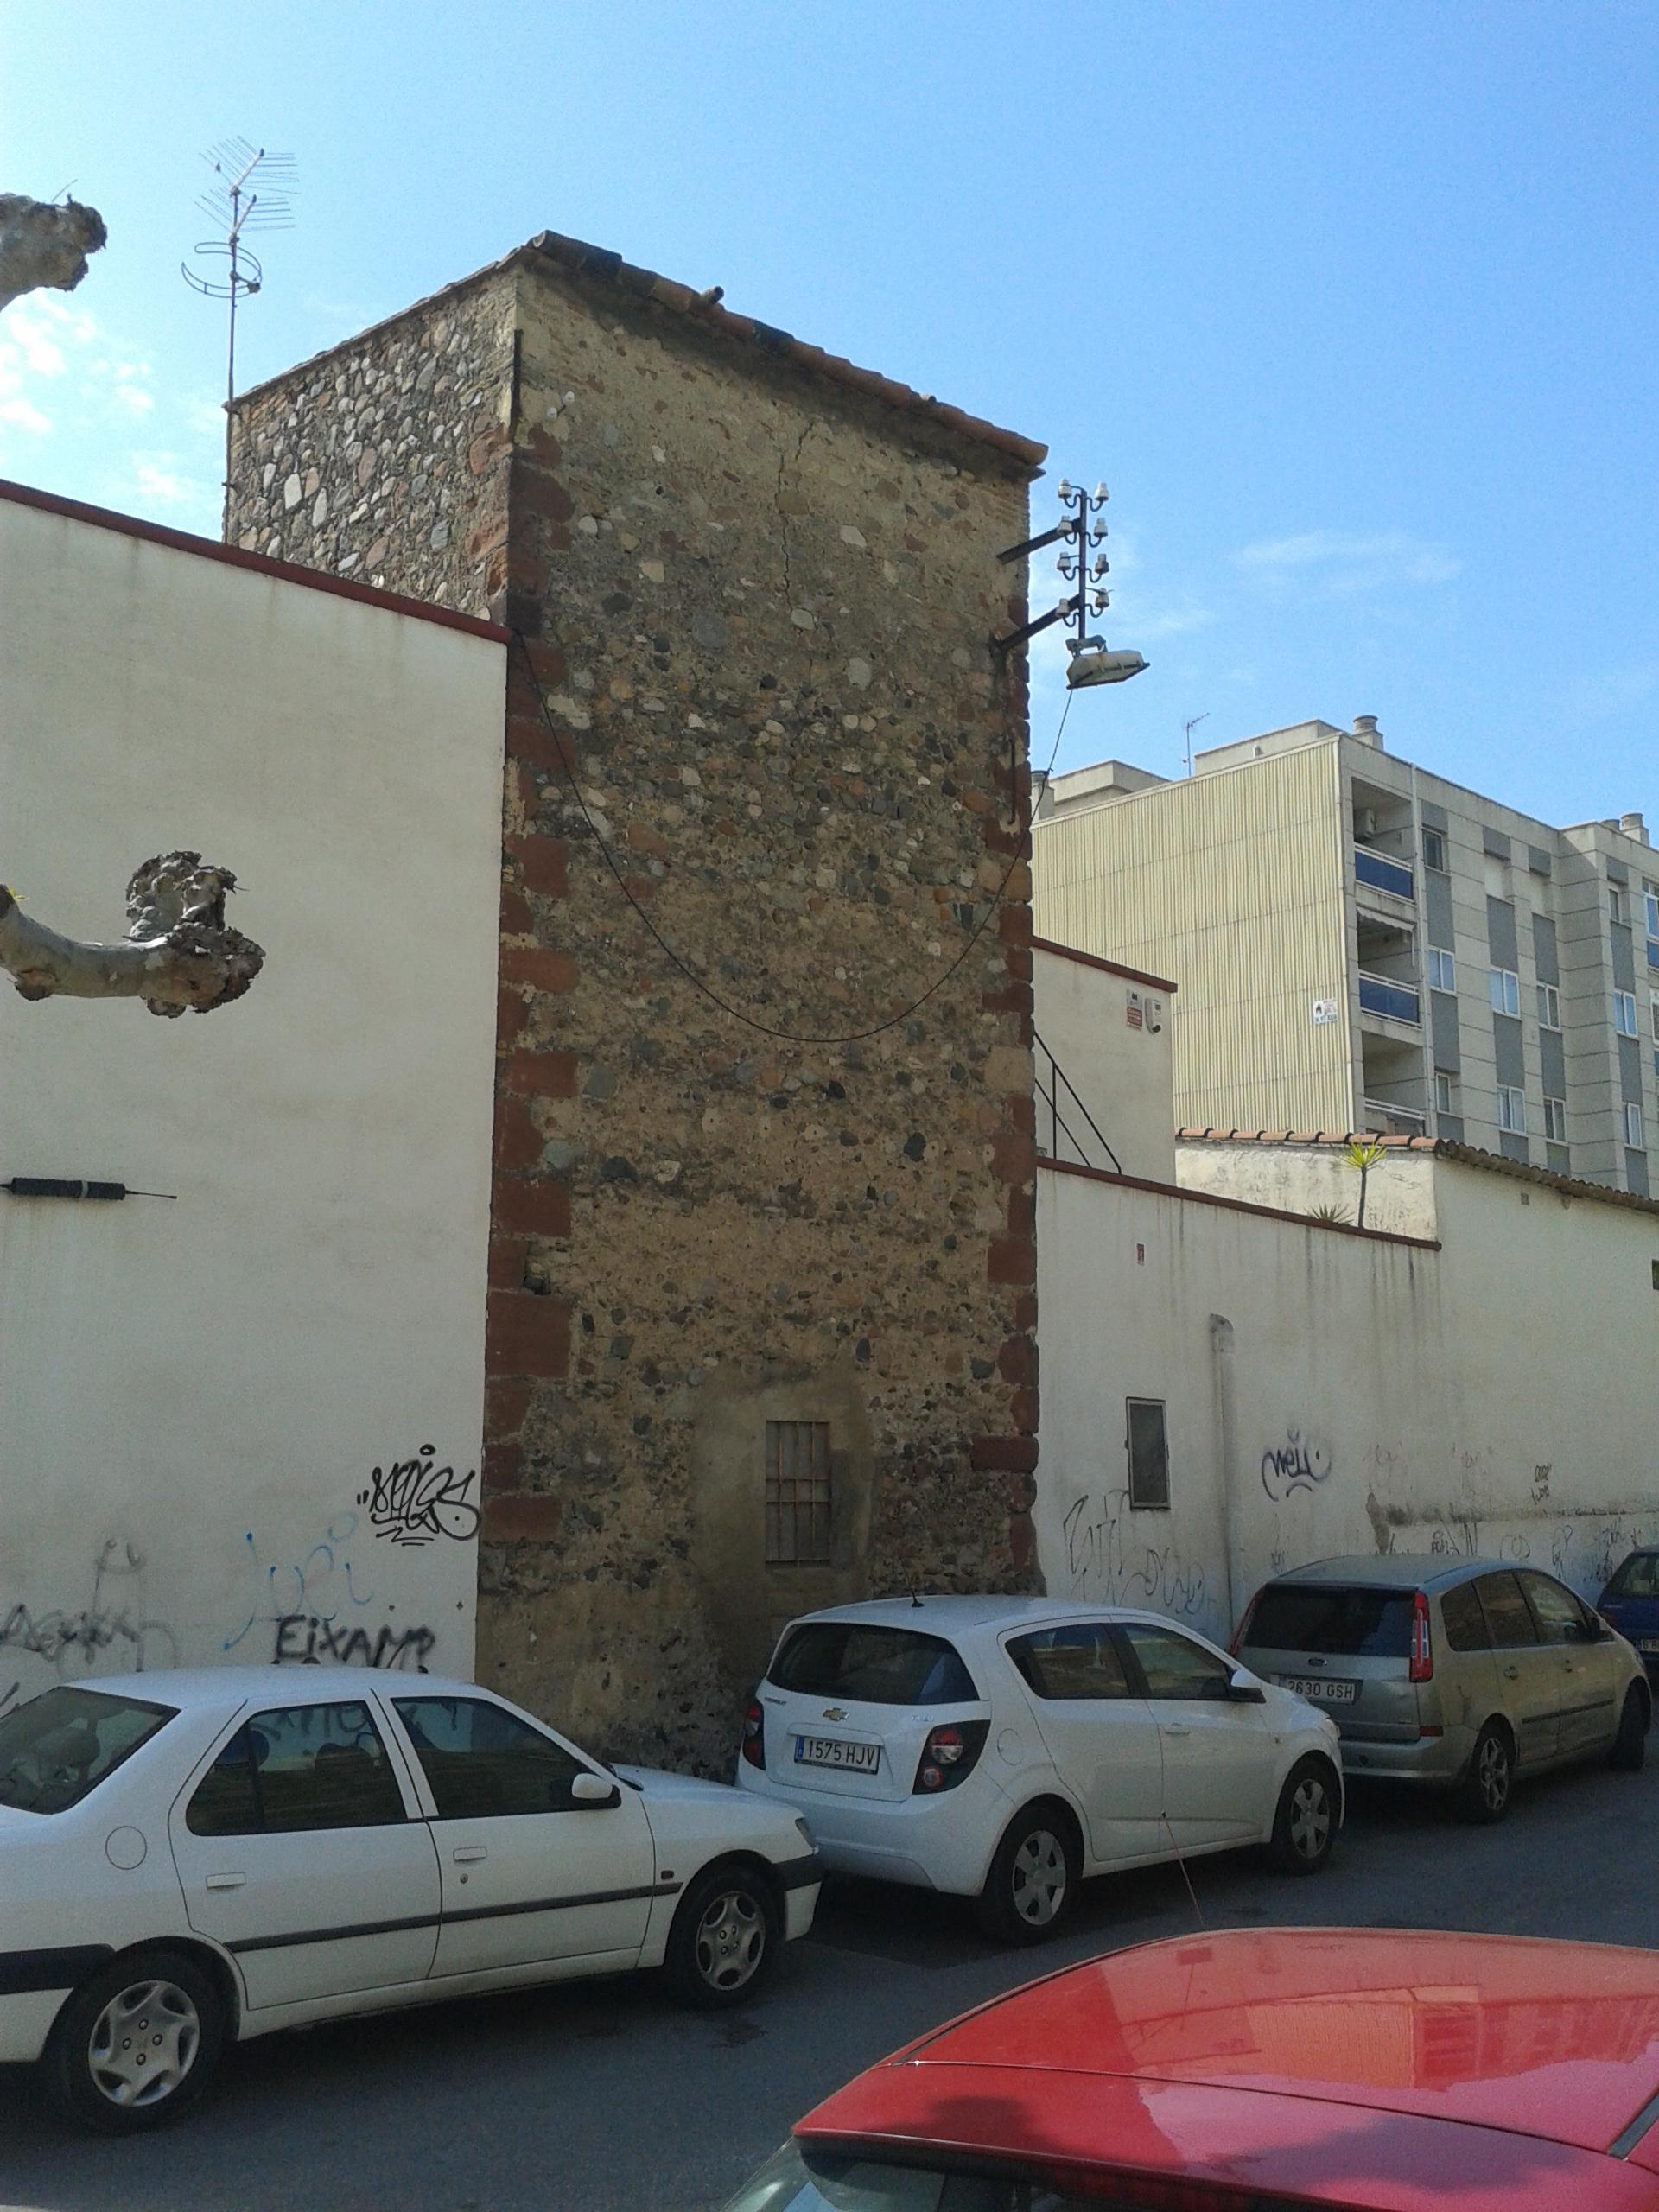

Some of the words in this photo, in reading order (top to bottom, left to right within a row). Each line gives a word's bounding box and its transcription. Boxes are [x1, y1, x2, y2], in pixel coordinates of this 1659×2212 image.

[1288, 1680, 1321, 1697] 2630
[1326, 1684, 1353, 1700] GSH
[809, 1740, 842, 1761] 1575
[846, 1743, 875, 1766] HJV
